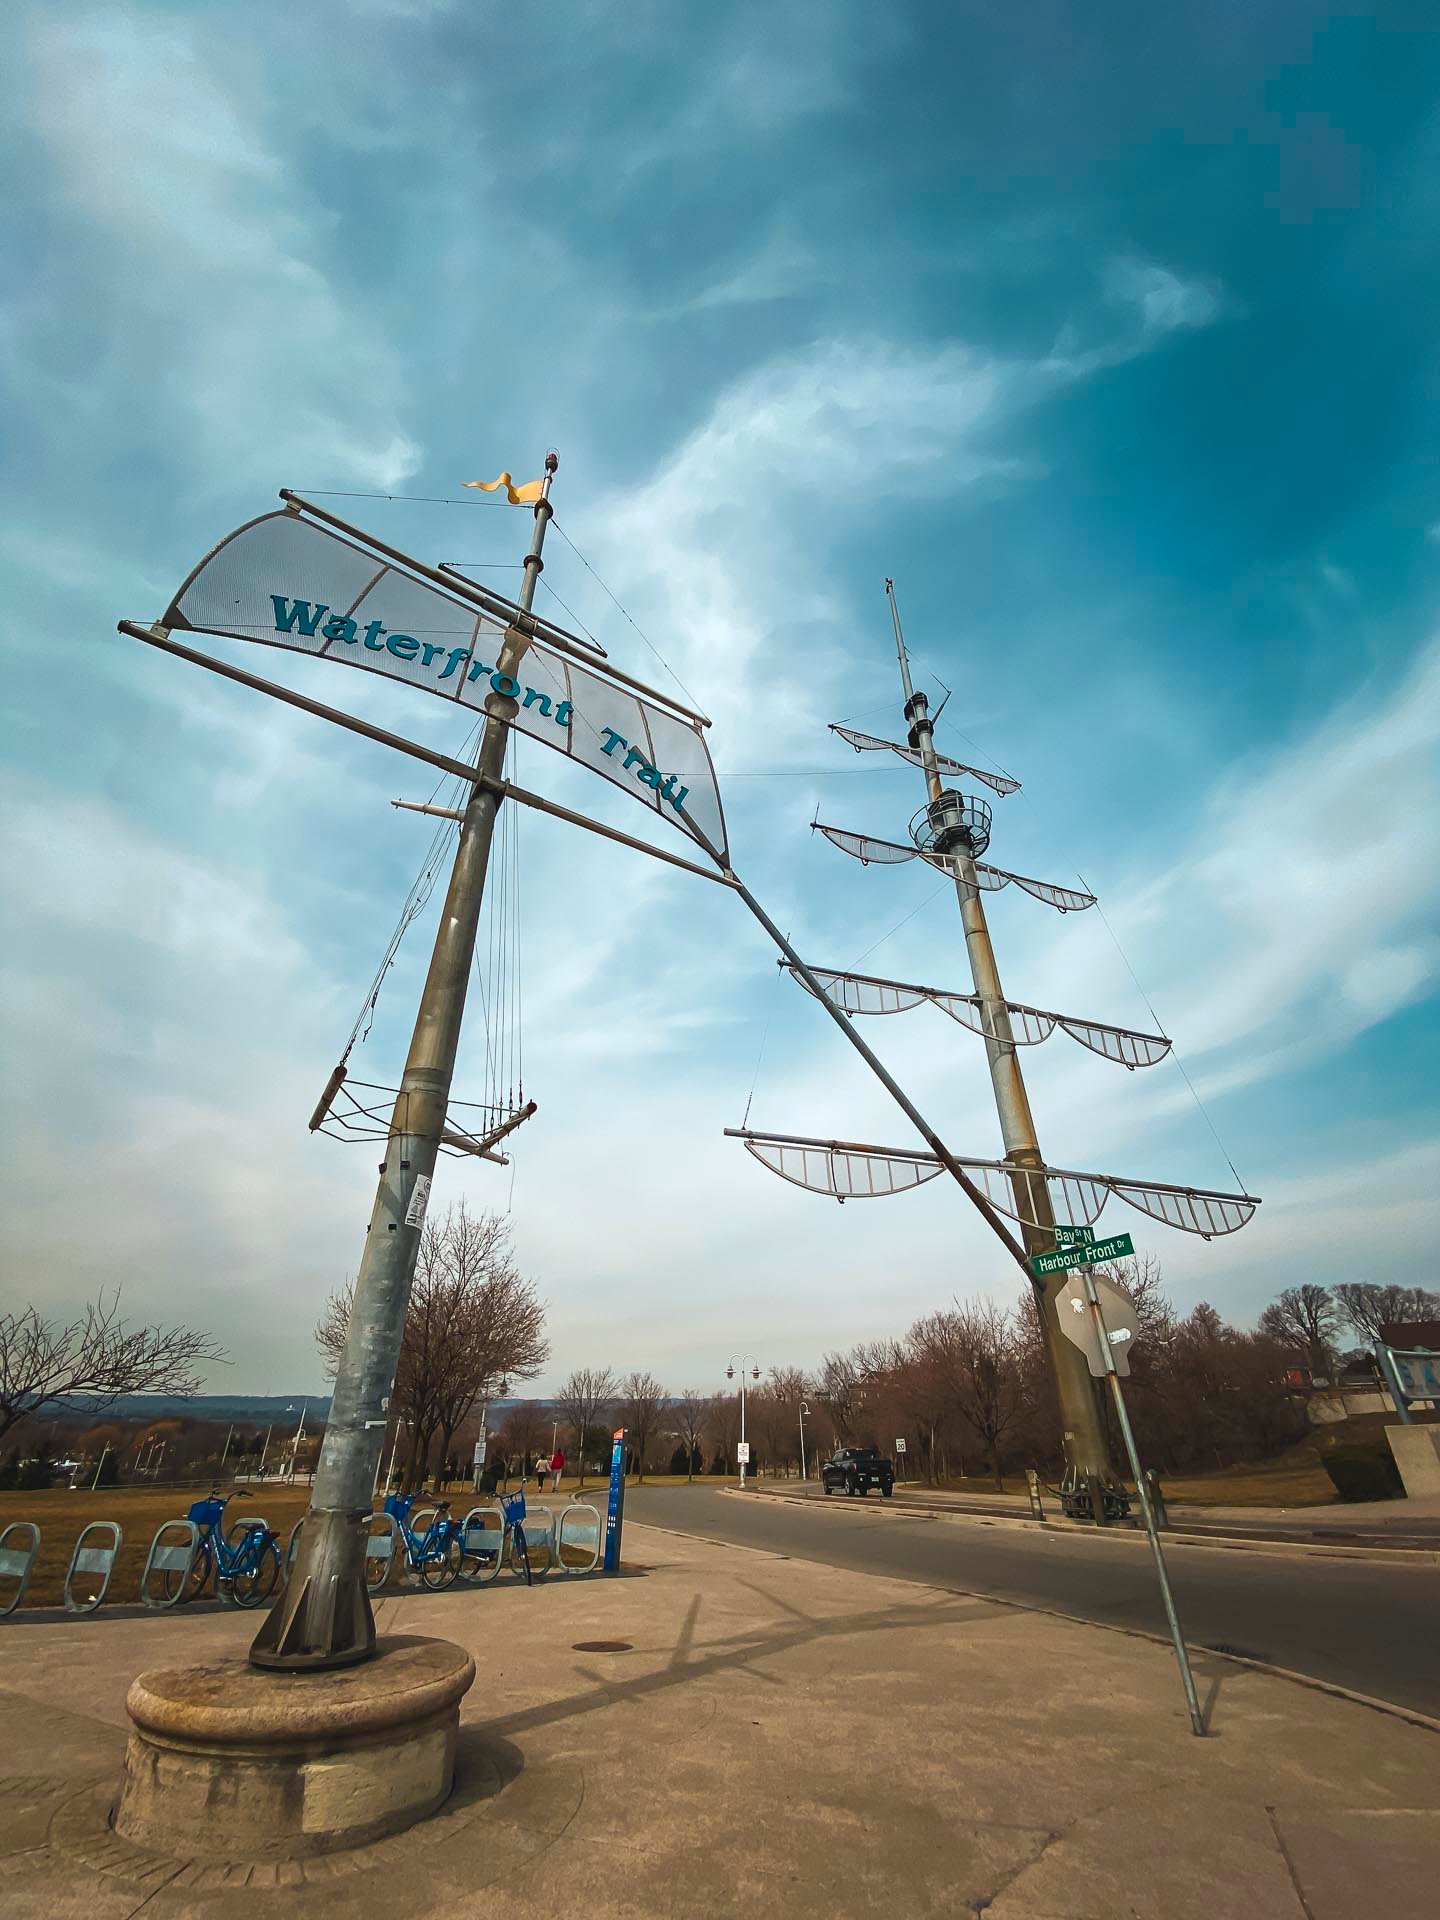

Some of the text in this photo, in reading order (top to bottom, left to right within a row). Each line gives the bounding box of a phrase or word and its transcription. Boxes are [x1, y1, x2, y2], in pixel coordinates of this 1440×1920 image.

[269, 594, 690, 812] Waterfront Trail
[1054, 1228, 1093, 1243] Bay St N
[1039, 1240, 1125, 1272] Harbour Front Dr
